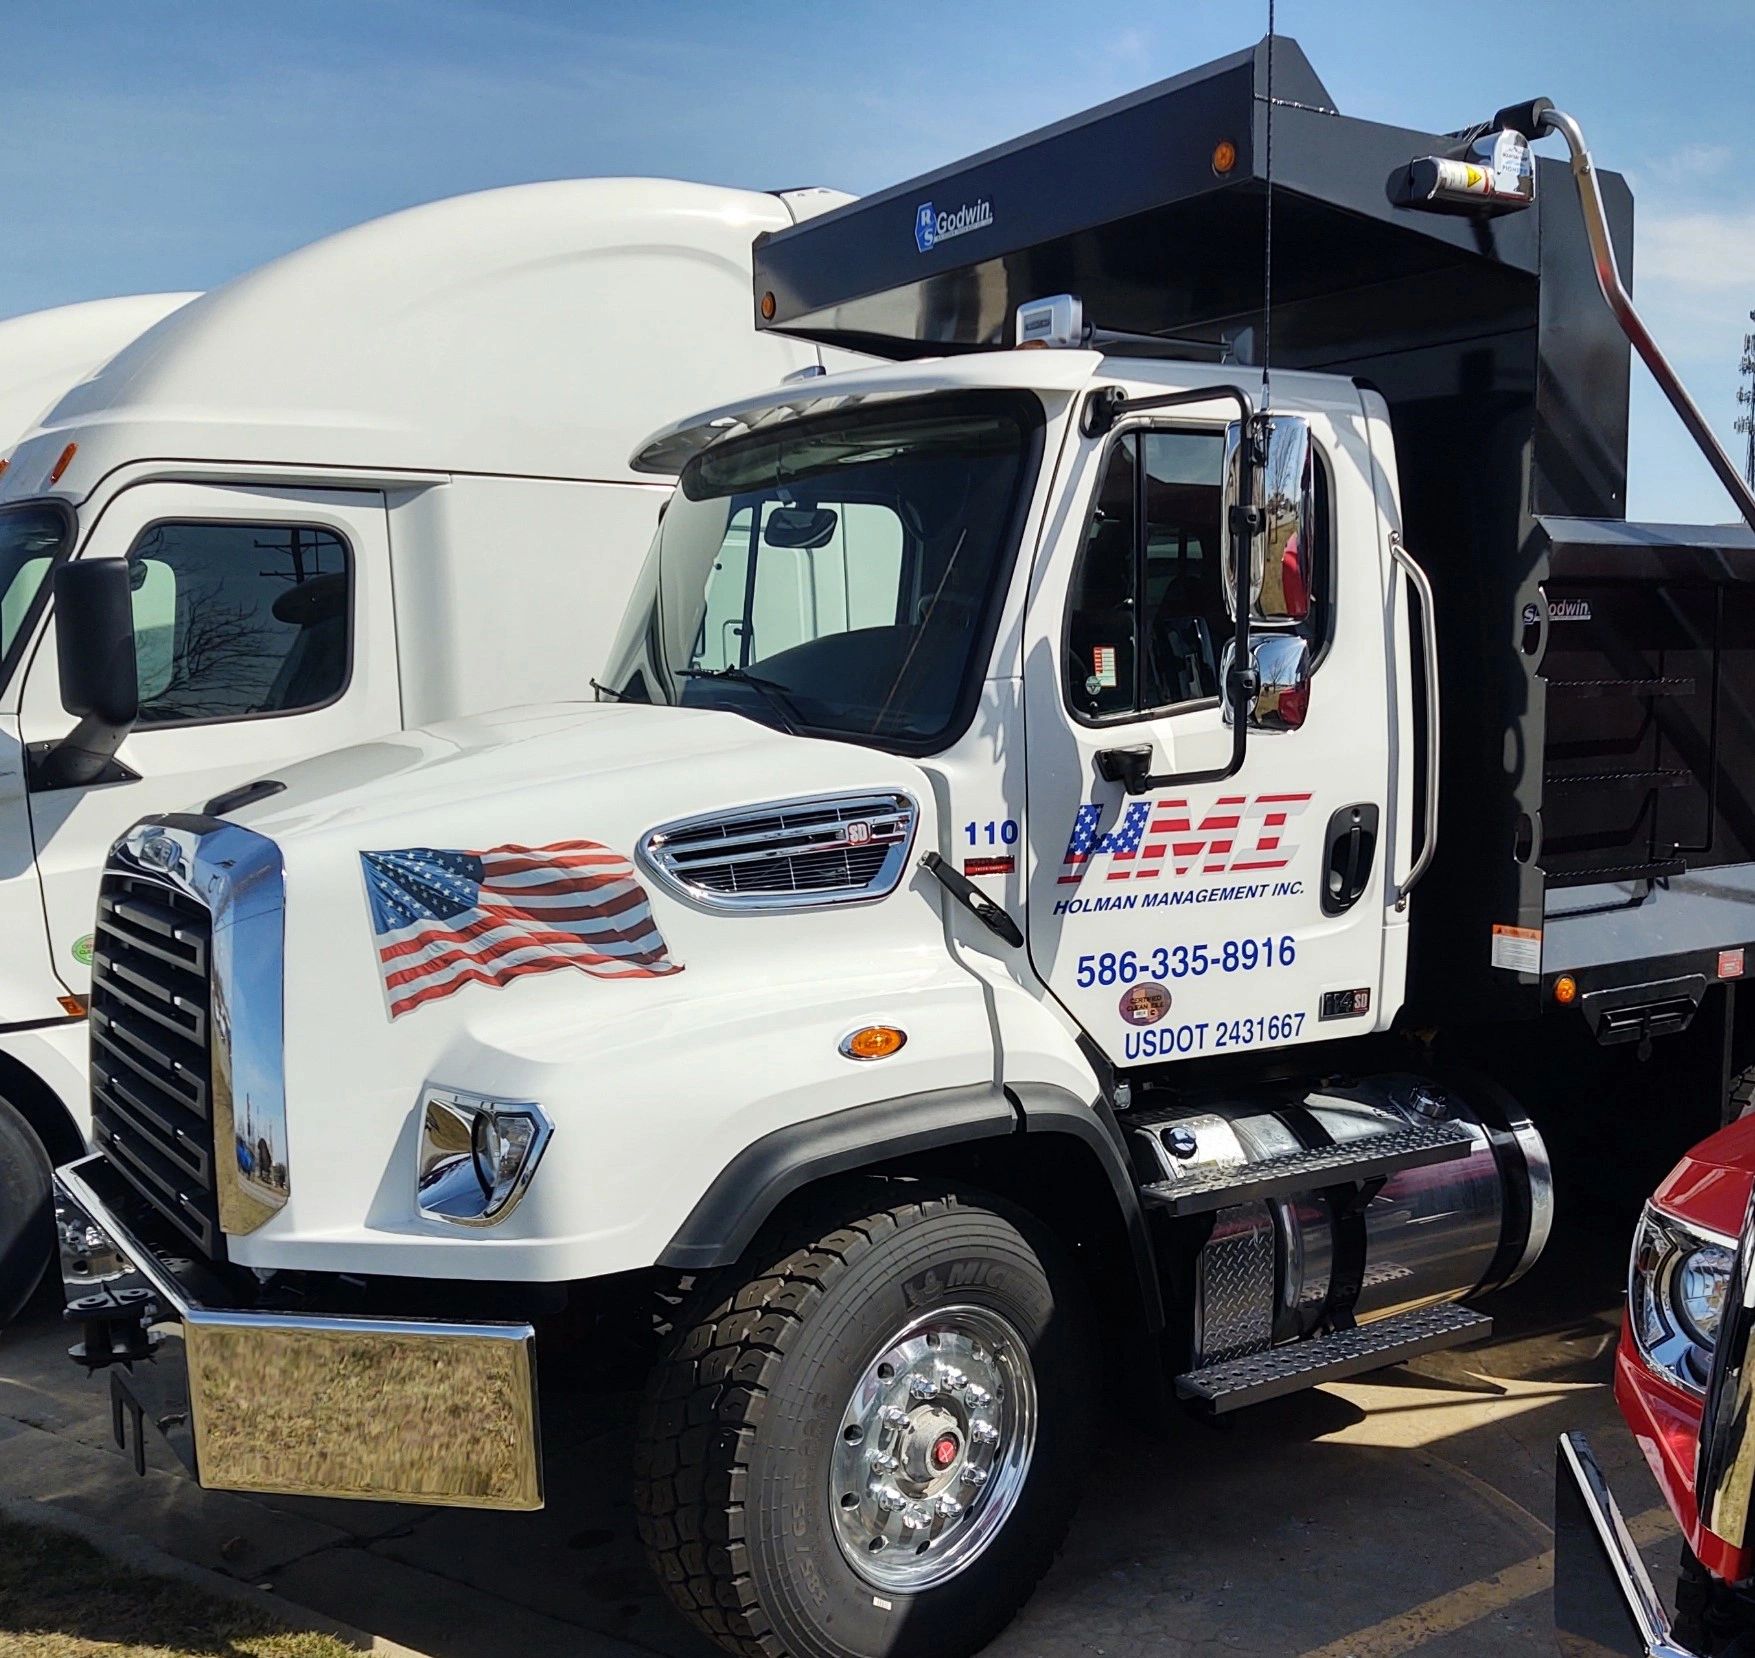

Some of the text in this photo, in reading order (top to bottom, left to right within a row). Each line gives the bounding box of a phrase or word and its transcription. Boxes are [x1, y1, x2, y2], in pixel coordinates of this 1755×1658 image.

[936, 199, 990, 234] Godwin
[1546, 599, 1589, 616] odwin
[848, 823, 868, 843] SD
[964, 819, 1018, 846] 110
[1056, 791, 1316, 885] HMI
[1052, 881, 1304, 916] HOLMAN MANAGEMENT INC.
[1077, 936, 1296, 988] 586-335-8916
[1354, 993, 1368, 1009] SD
[1125, 1012, 1306, 1060] USDOT 2431667
